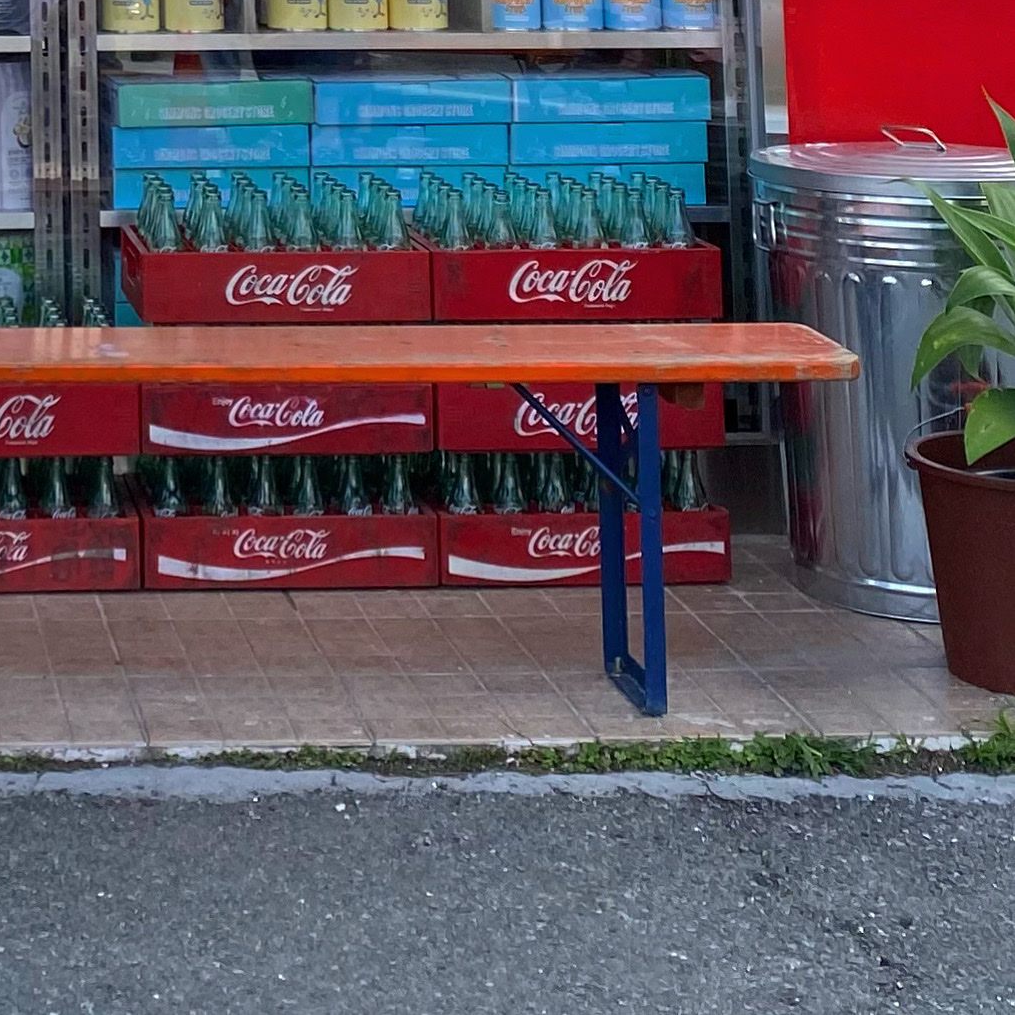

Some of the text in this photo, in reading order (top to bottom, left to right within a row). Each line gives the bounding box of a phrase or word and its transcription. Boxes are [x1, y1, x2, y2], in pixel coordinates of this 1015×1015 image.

[225, 264, 359, 306] Coca-Cola
[509, 259, 638, 303] Coca-Cola
[228, 396, 326, 427] Coca-Cola
[233, 529, 331, 560] Coca-Cola
[528, 526, 600, 558] Coca-Co
